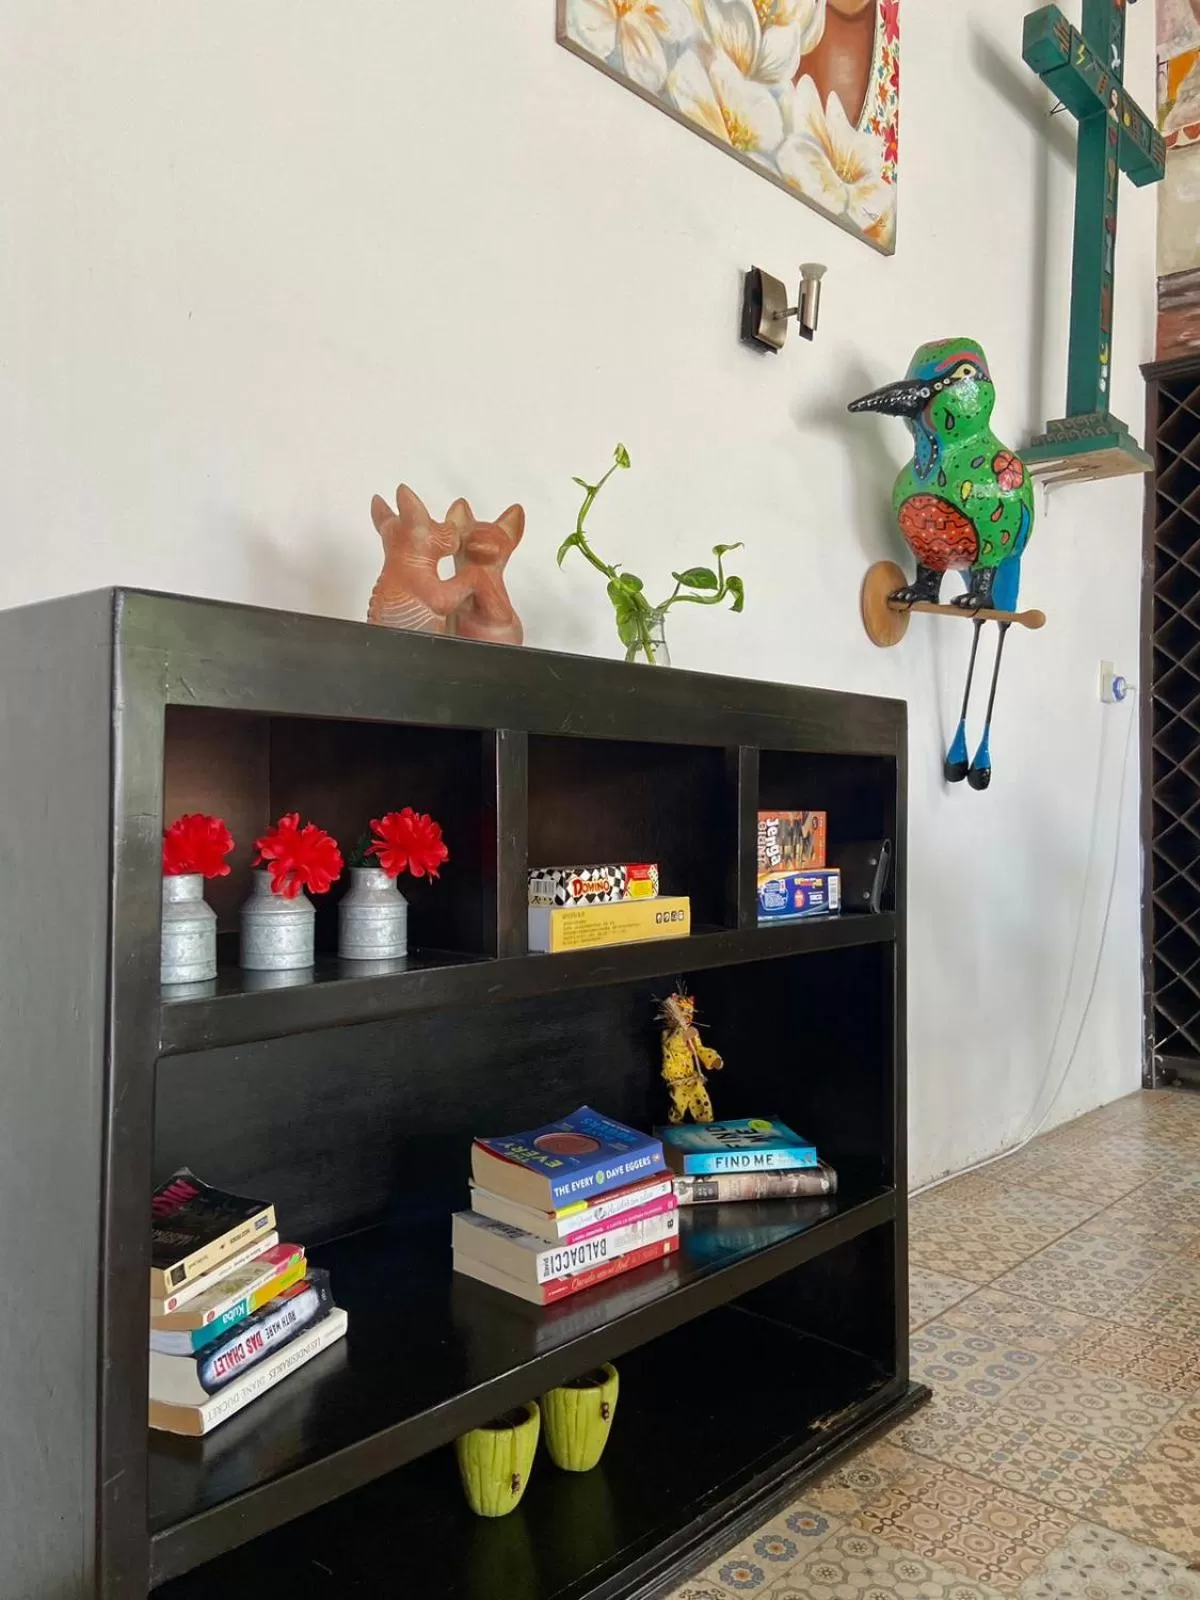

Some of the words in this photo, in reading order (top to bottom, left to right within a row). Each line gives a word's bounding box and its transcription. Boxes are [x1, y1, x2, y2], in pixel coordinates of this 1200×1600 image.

[766, 818, 781, 866] Jenga
[572, 878, 610, 897] DOMINO
[715, 1155, 750, 1169] FIND
[753, 1154, 774, 1167] ME
[553, 1184, 570, 1198] THE
[571, 1175, 594, 1192] EVERY
[605, 1165, 624, 1180] DAVE
[625, 1155, 651, 1172] EGGERS
[550, 1238, 607, 1274] BALDACCI
[222, 1303, 245, 1324] Kuba
[245, 1331, 264, 1354] DAS
[213, 1343, 246, 1377] CHALET
